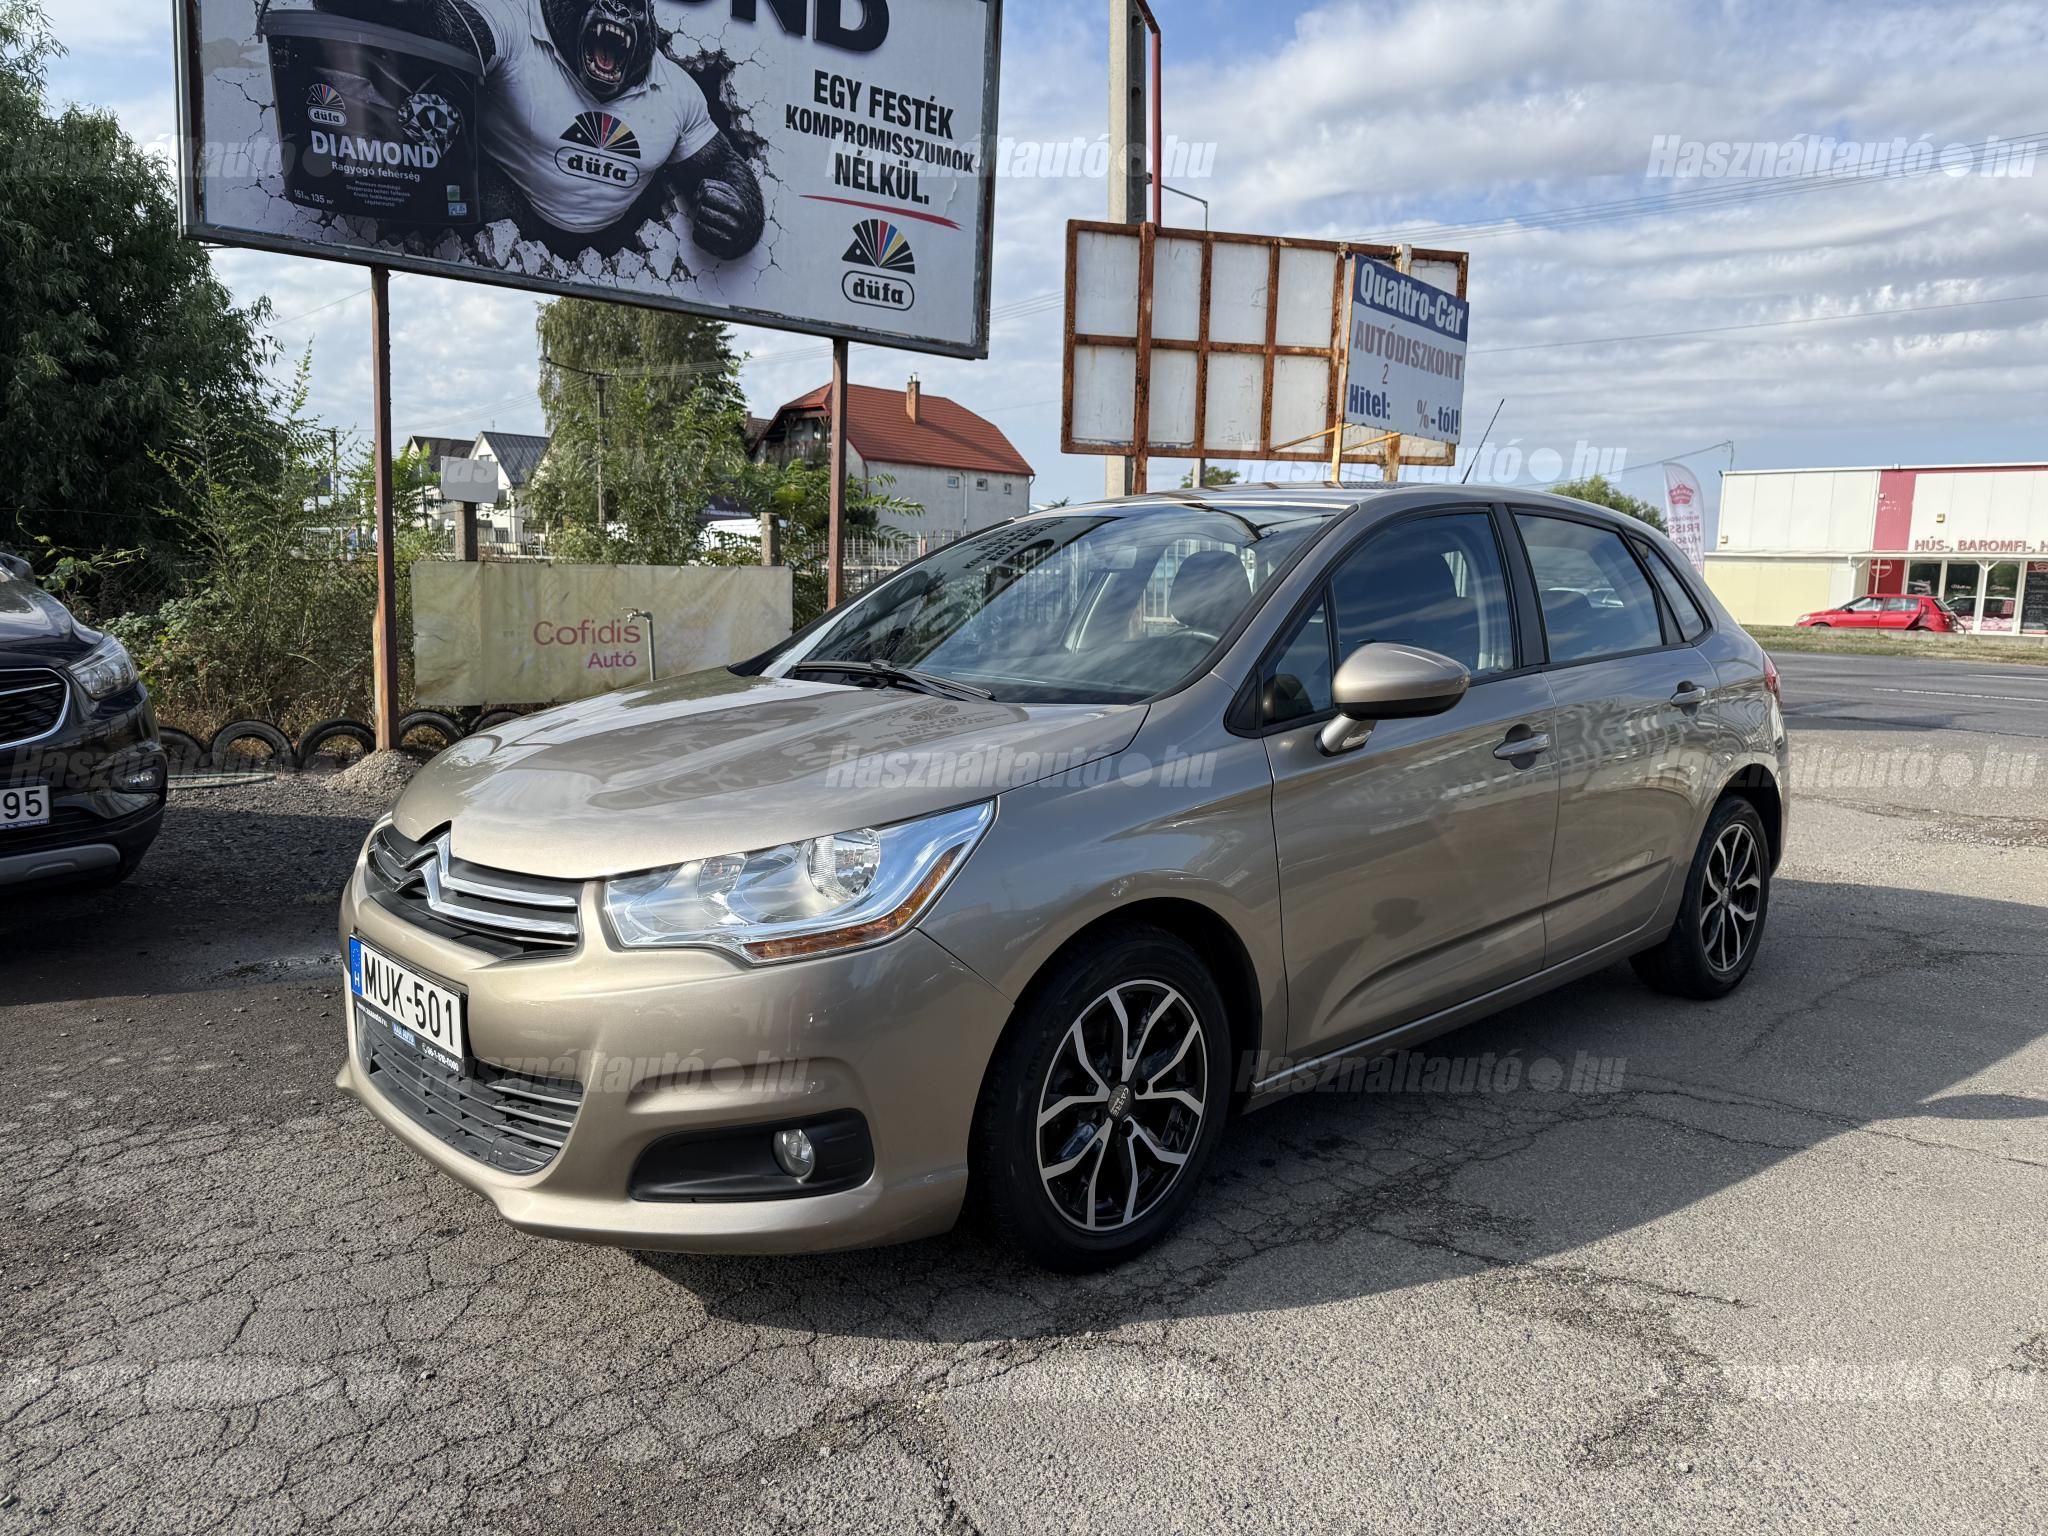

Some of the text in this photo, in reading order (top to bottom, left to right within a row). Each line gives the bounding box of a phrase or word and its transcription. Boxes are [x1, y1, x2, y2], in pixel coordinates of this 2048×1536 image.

[313, 109, 340, 123] düfa
[813, 69, 954, 140] EGY FESTÉK
[310, 130, 439, 169] DIAMOND
[785, 103, 976, 174] KOMPROMISSZUMOK
[331, 161, 421, 183] Ragyogó fehérség
[566, 154, 628, 183] düfa
[834, 152, 930, 205] NÉLKÜL.
[852, 279, 905, 306] düfa
[1359, 262, 1465, 336] Quattro-Car
[1353, 319, 1464, 382] AUTÓDISZKONT
[1381, 363, 1389, 385] 2
[1348, 384, 1391, 421] Hitel:
[533, 619, 641, 646] Cofidis
[587, 650, 637, 670] Autó
[354, 951, 454, 1048] H MUK-501
